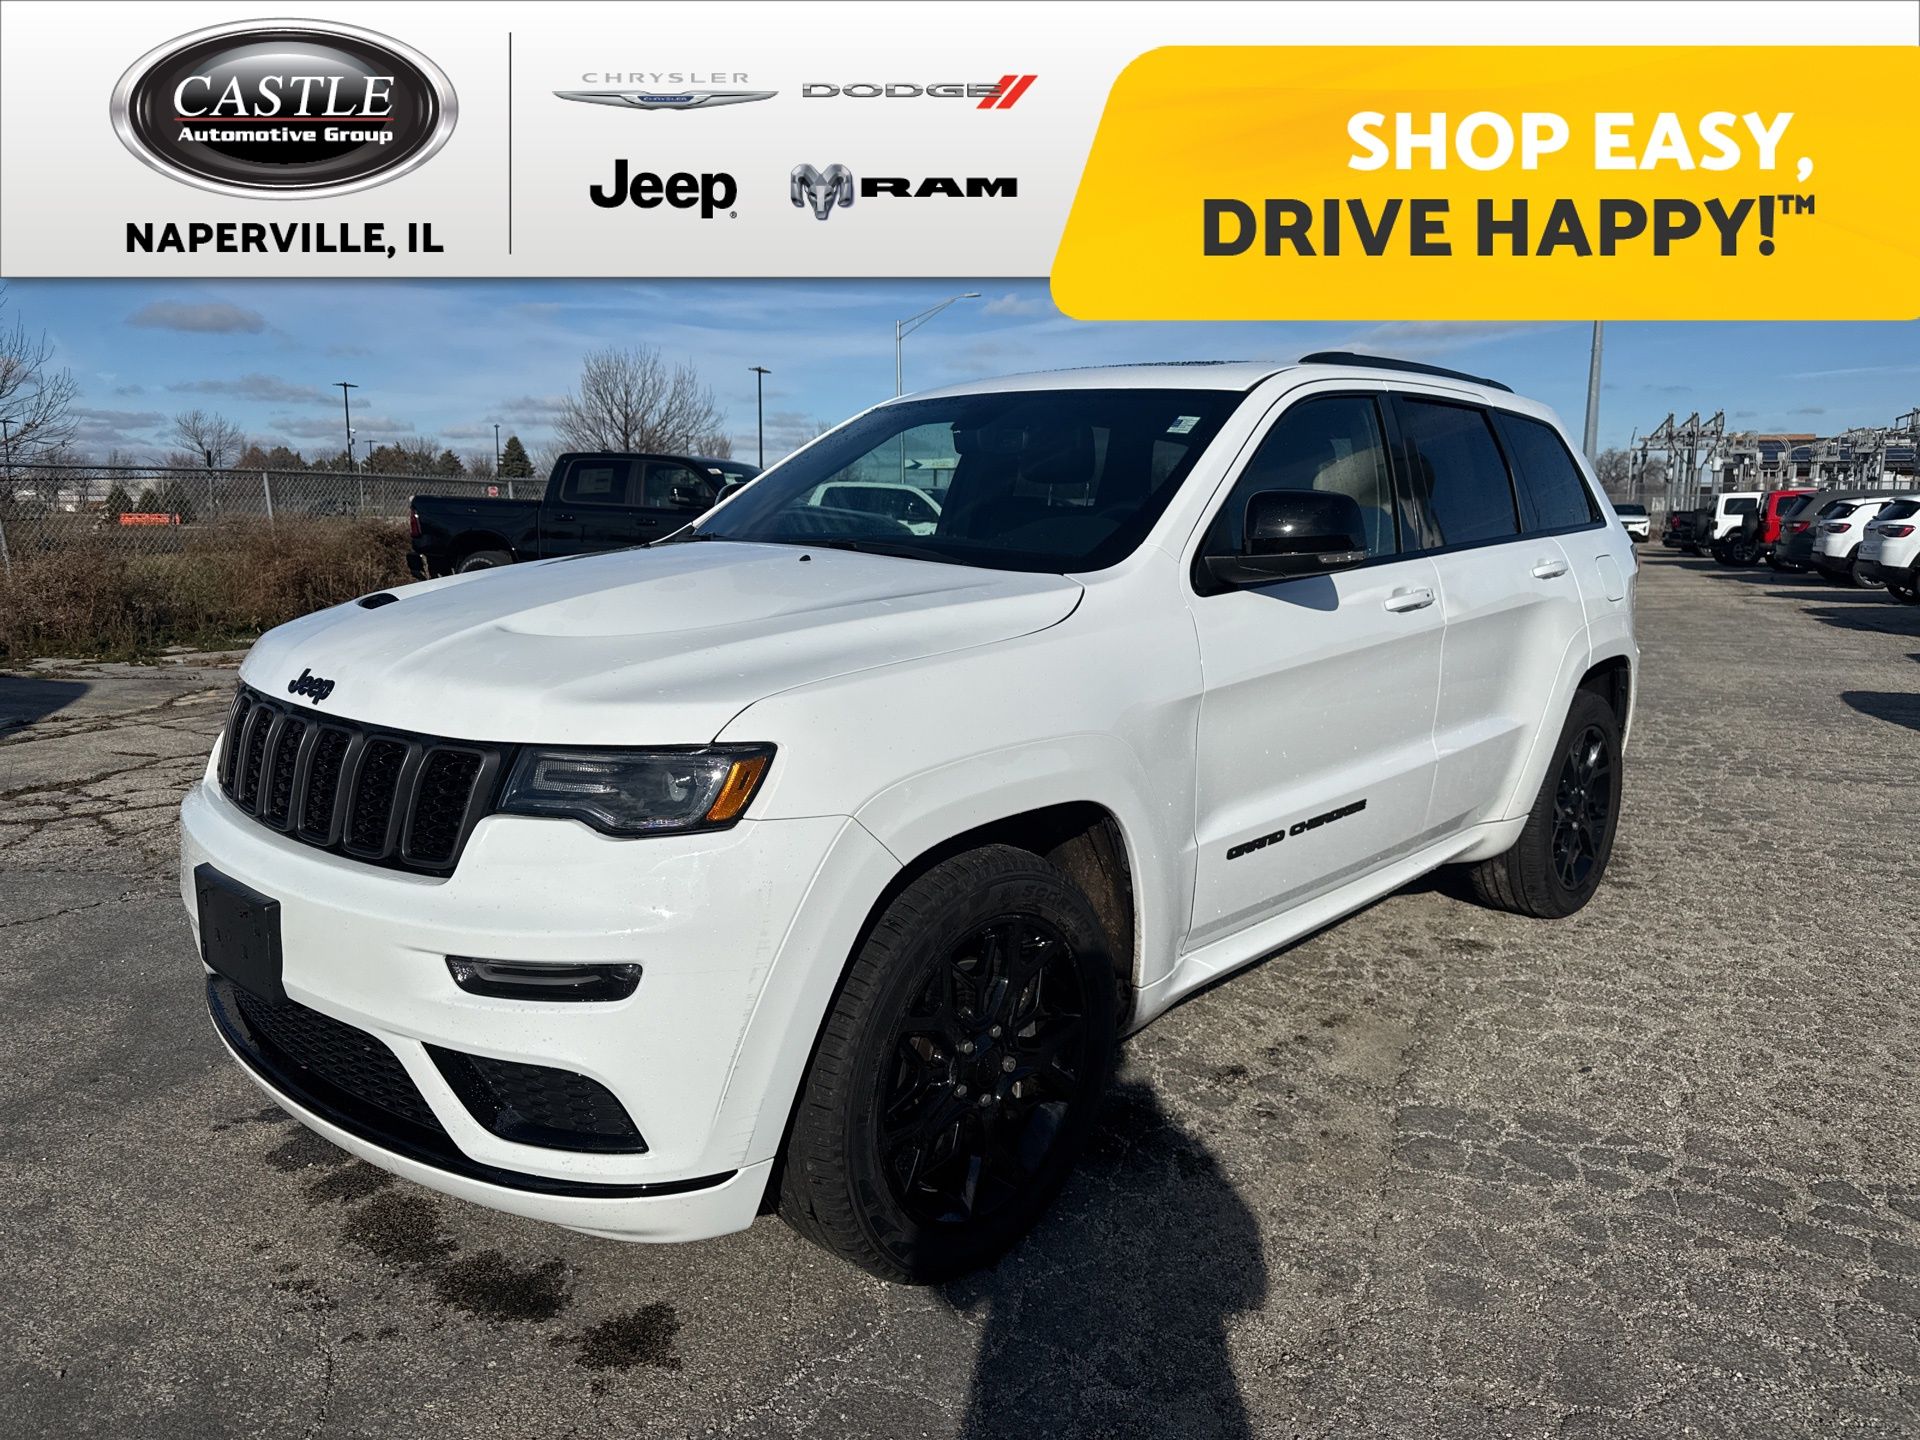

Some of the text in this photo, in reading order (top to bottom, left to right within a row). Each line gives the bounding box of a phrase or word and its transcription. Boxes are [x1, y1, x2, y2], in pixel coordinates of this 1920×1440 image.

[288, 668, 336, 705] Jeep
[1226, 798, 1368, 861] GRAND CHEROKEE
